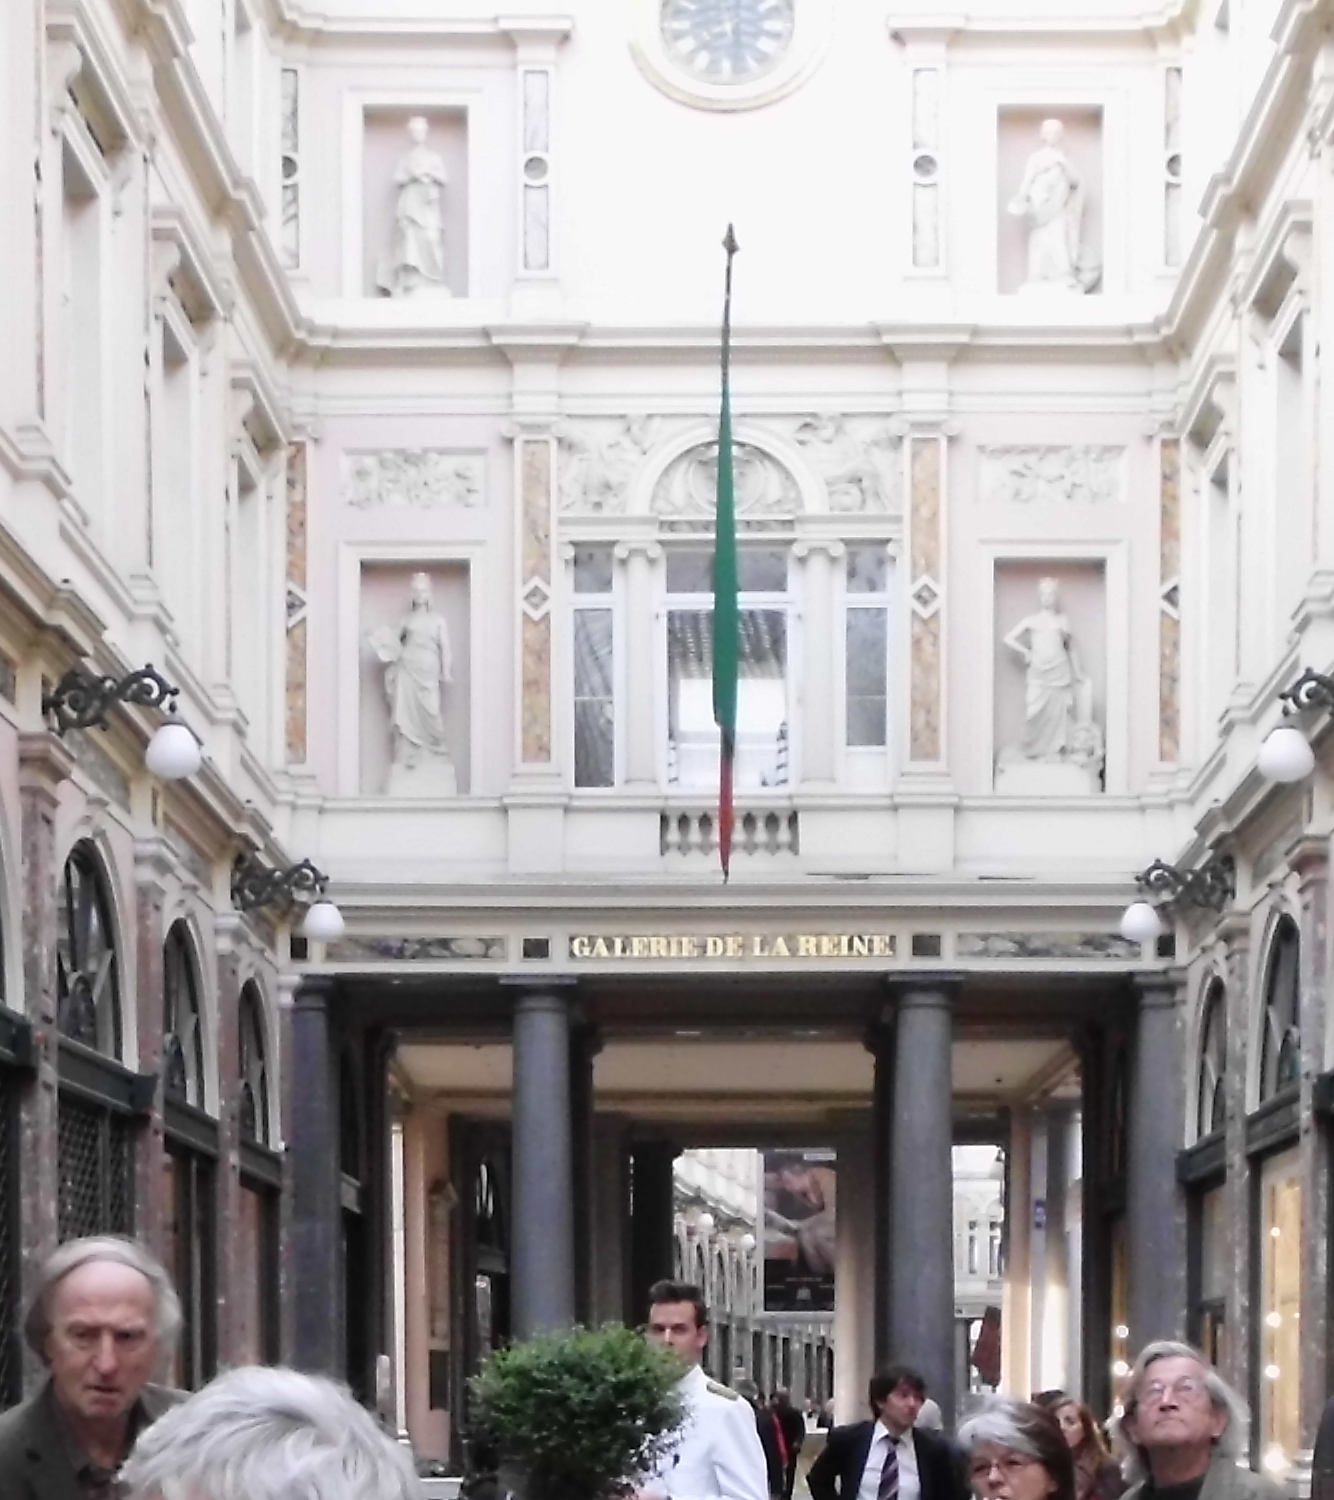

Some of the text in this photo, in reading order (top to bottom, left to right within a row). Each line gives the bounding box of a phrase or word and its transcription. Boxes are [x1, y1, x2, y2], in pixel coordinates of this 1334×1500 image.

[571, 934, 893, 957] GALERIE DE LA REINE
